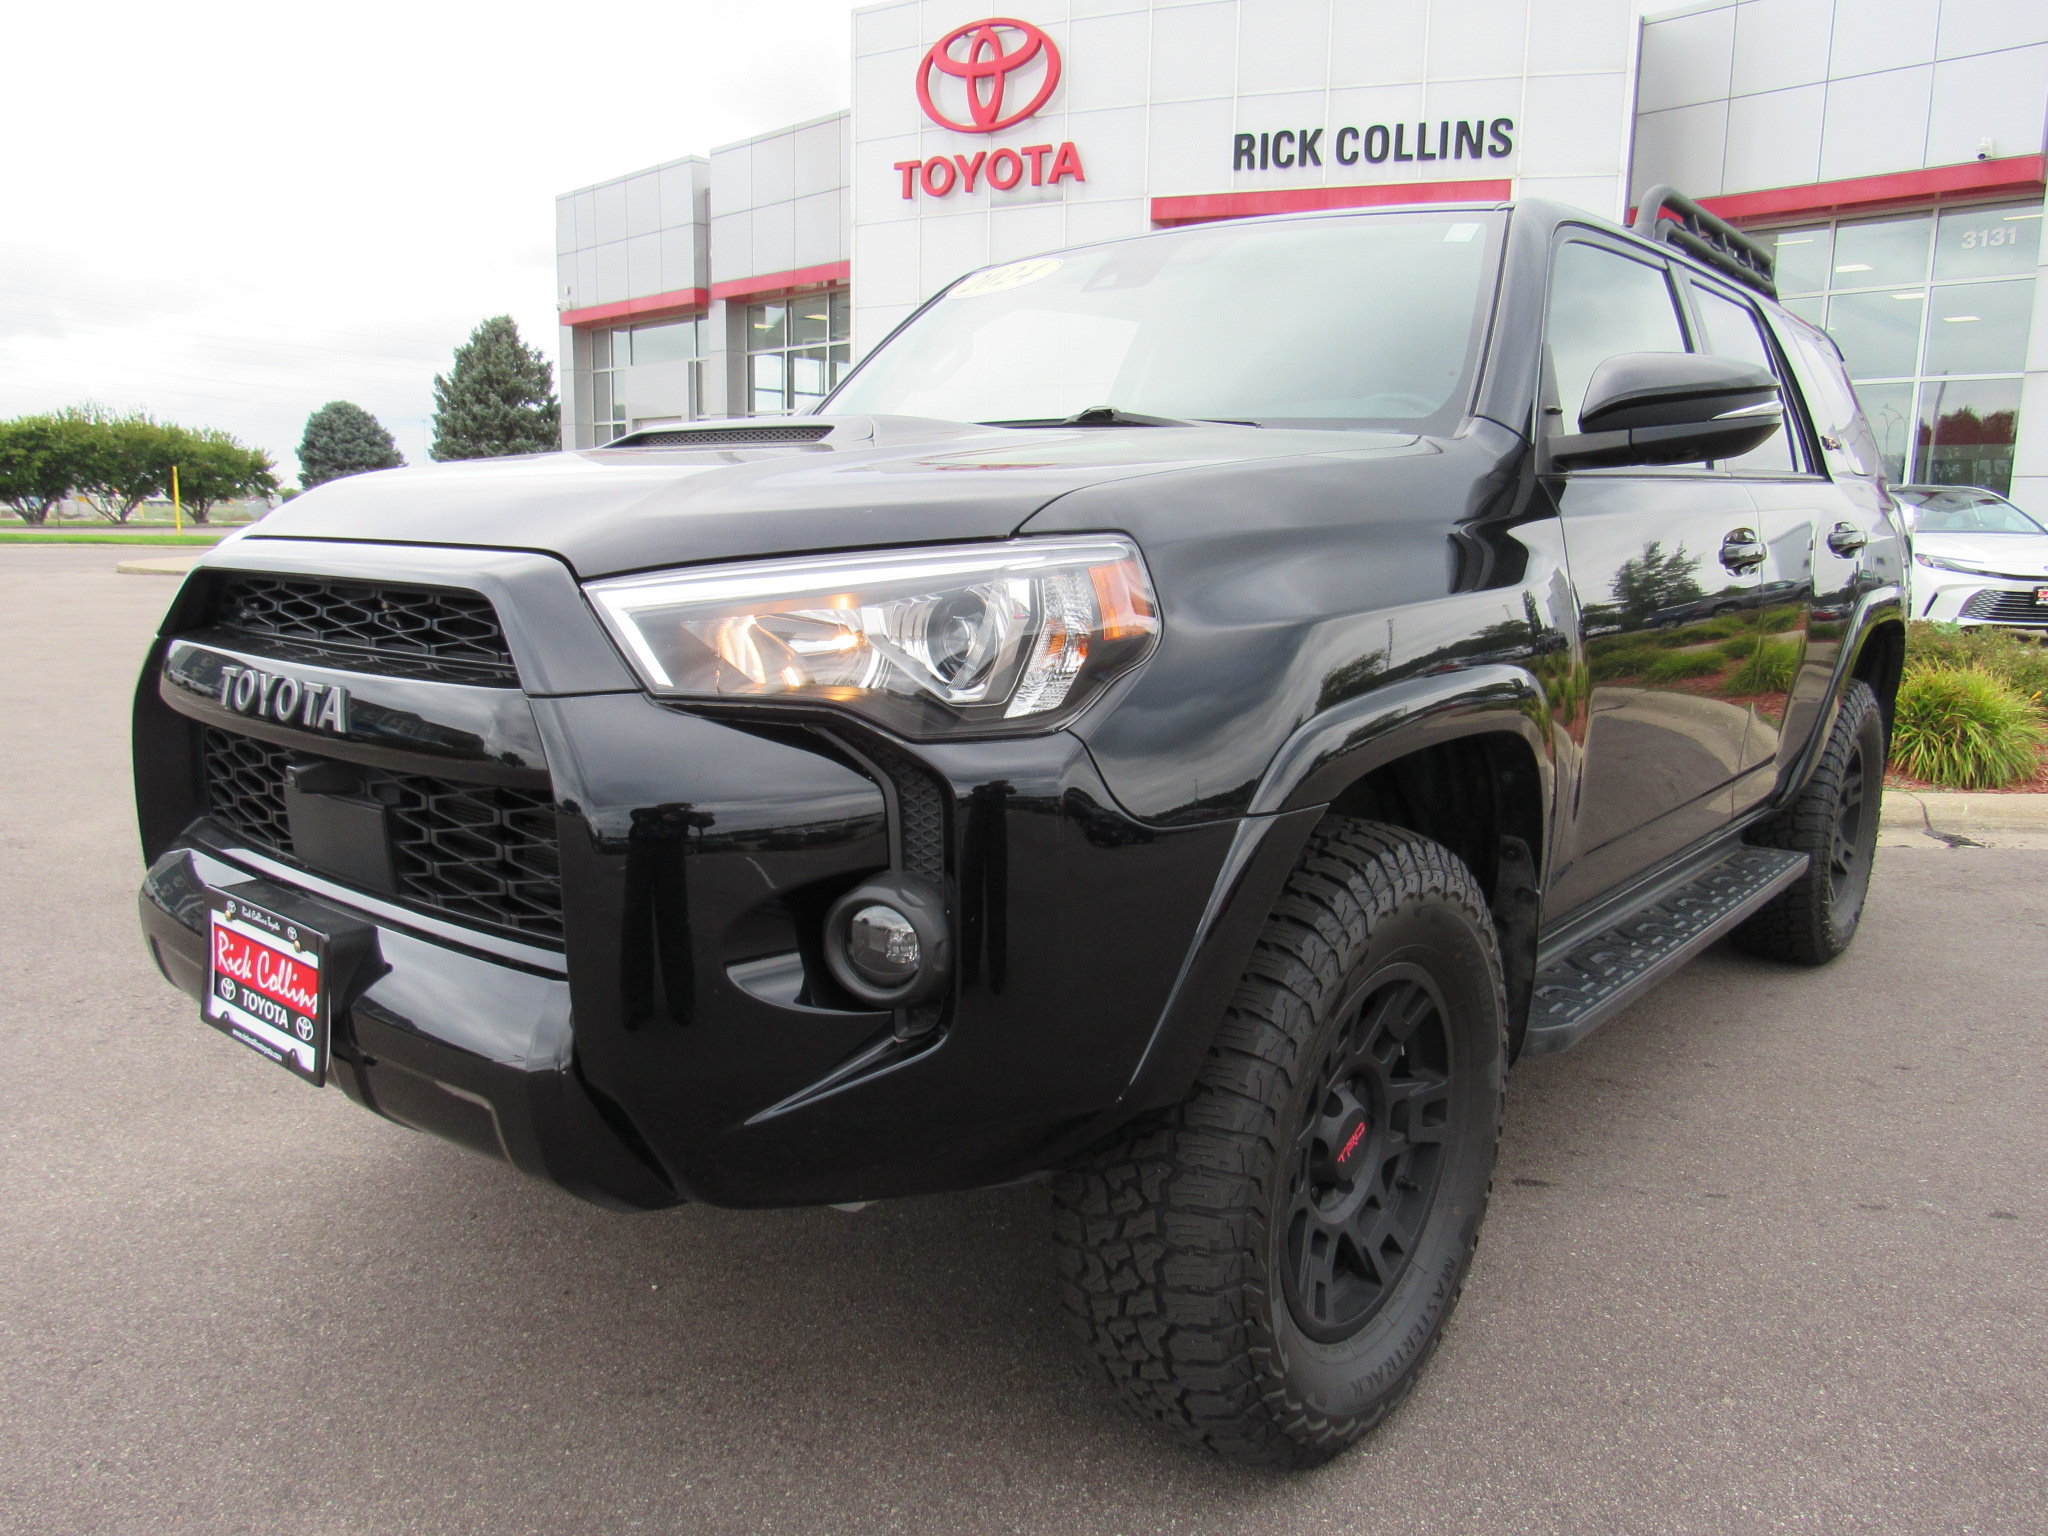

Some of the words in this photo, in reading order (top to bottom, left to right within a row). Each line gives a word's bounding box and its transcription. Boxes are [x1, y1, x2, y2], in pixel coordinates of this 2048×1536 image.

[1232, 128, 1323, 171] RICK
[1335, 117, 1514, 163] COLLINS
[894, 141, 1086, 200] TOYOTA
[1961, 226, 2017, 250] 3131
[220, 665, 351, 733] TOYOTA
[216, 931, 252, 980] Rick
[241, 988, 289, 1029] TOYOTA
[1337, 1121, 1366, 1164] TRD
